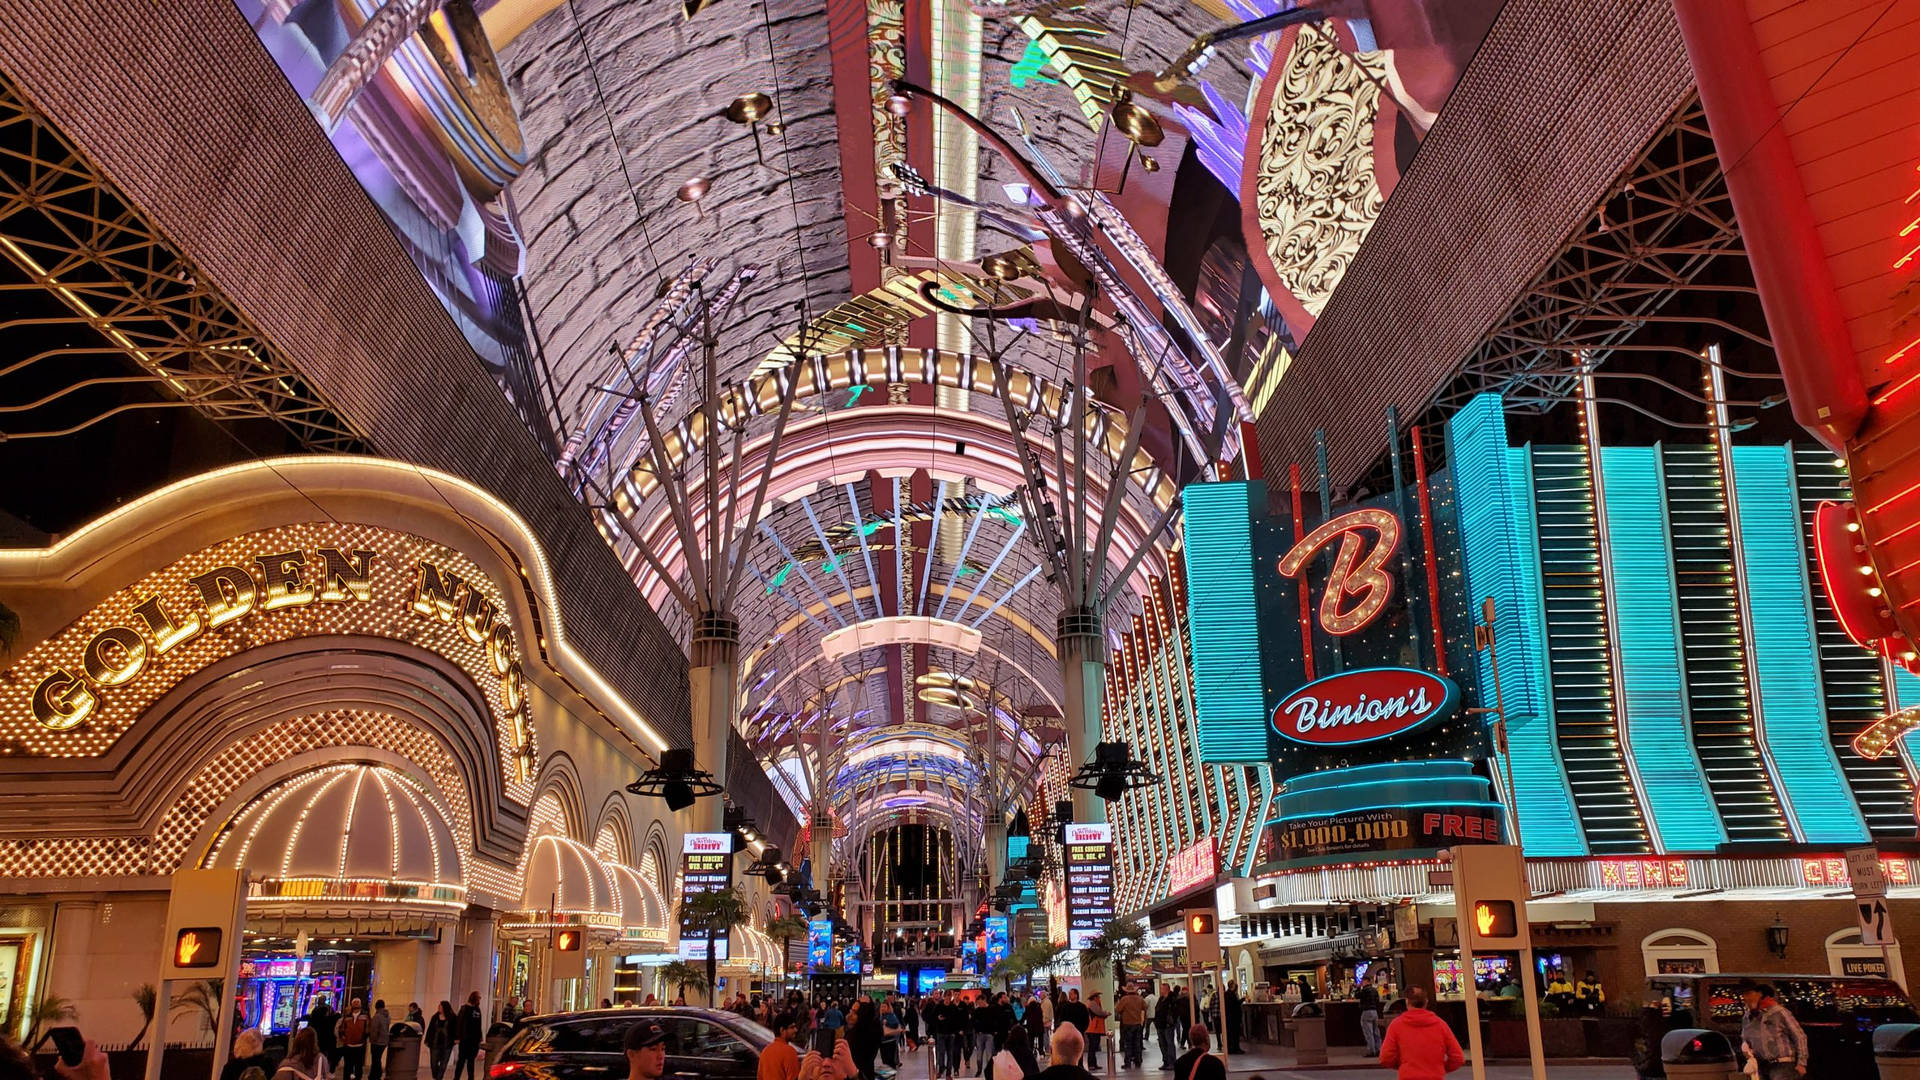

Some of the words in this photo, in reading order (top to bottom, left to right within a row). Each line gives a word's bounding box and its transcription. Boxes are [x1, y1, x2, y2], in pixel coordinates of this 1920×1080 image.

[1278, 508, 1400, 635] B
[31, 548, 378, 731] GOLDEN
[408, 559, 535, 784] NUGGET
[1284, 689, 1432, 733] Binion's
[1289, 823, 1306, 831] Take
[1308, 820, 1327, 828] Your
[1329, 816, 1364, 825] Picture
[1366, 812, 1393, 821] With
[1423, 813, 1498, 841] FREE
[1280, 820, 1409, 850] $1,000,000
[1864, 853, 1875, 861] LANE
[1600, 860, 1687, 886] KENO
[1857, 867, 1874, 876] MUST
[1871, 881, 1883, 889] LEFT
[1846, 963, 1862, 972] LIVE
[1863, 963, 1886, 972] POKER
